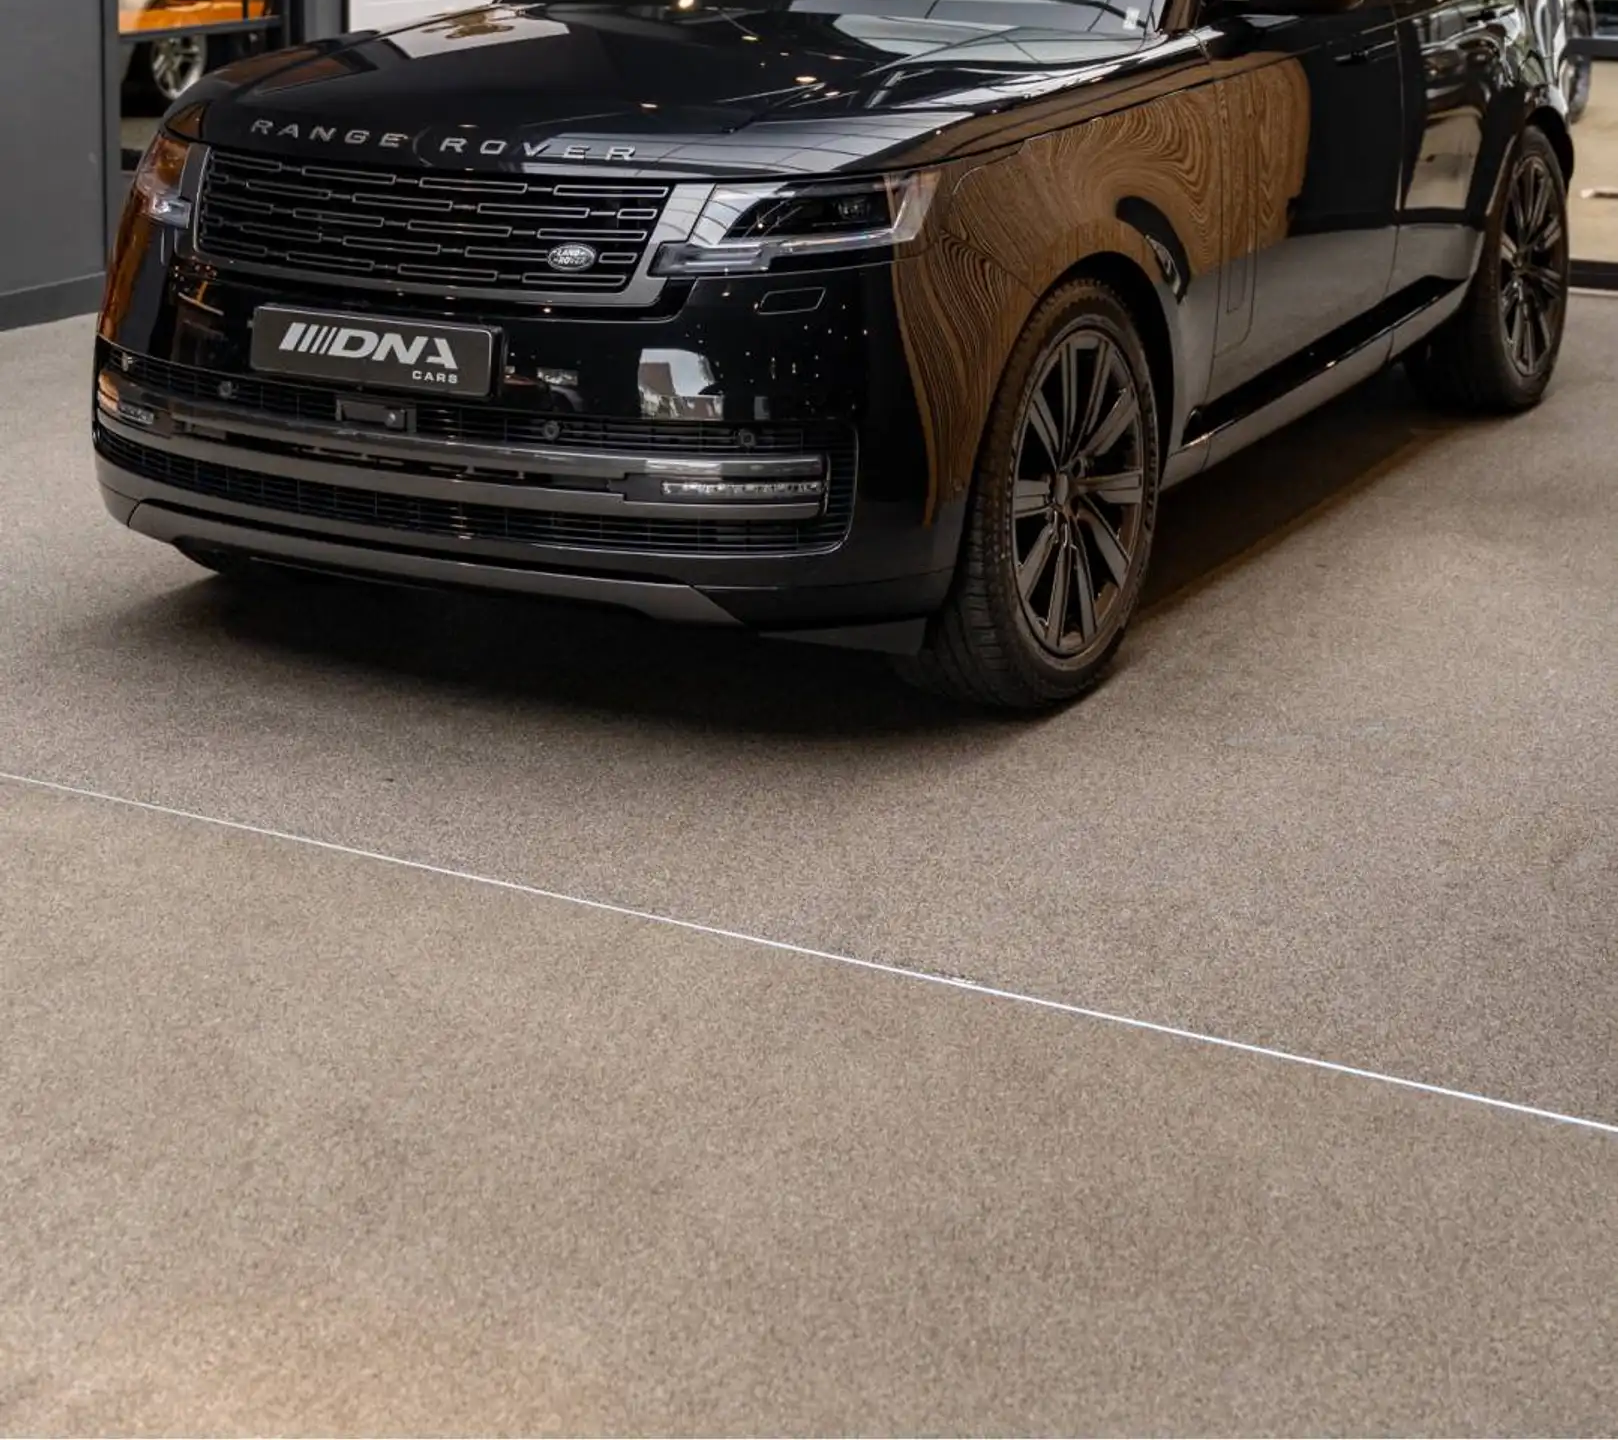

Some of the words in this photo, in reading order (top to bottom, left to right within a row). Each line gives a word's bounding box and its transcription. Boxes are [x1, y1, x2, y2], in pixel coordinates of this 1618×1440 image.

[251, 119, 409, 148] RANGE
[439, 137, 636, 160] ROVER
[412, 370, 458, 384] CARS
